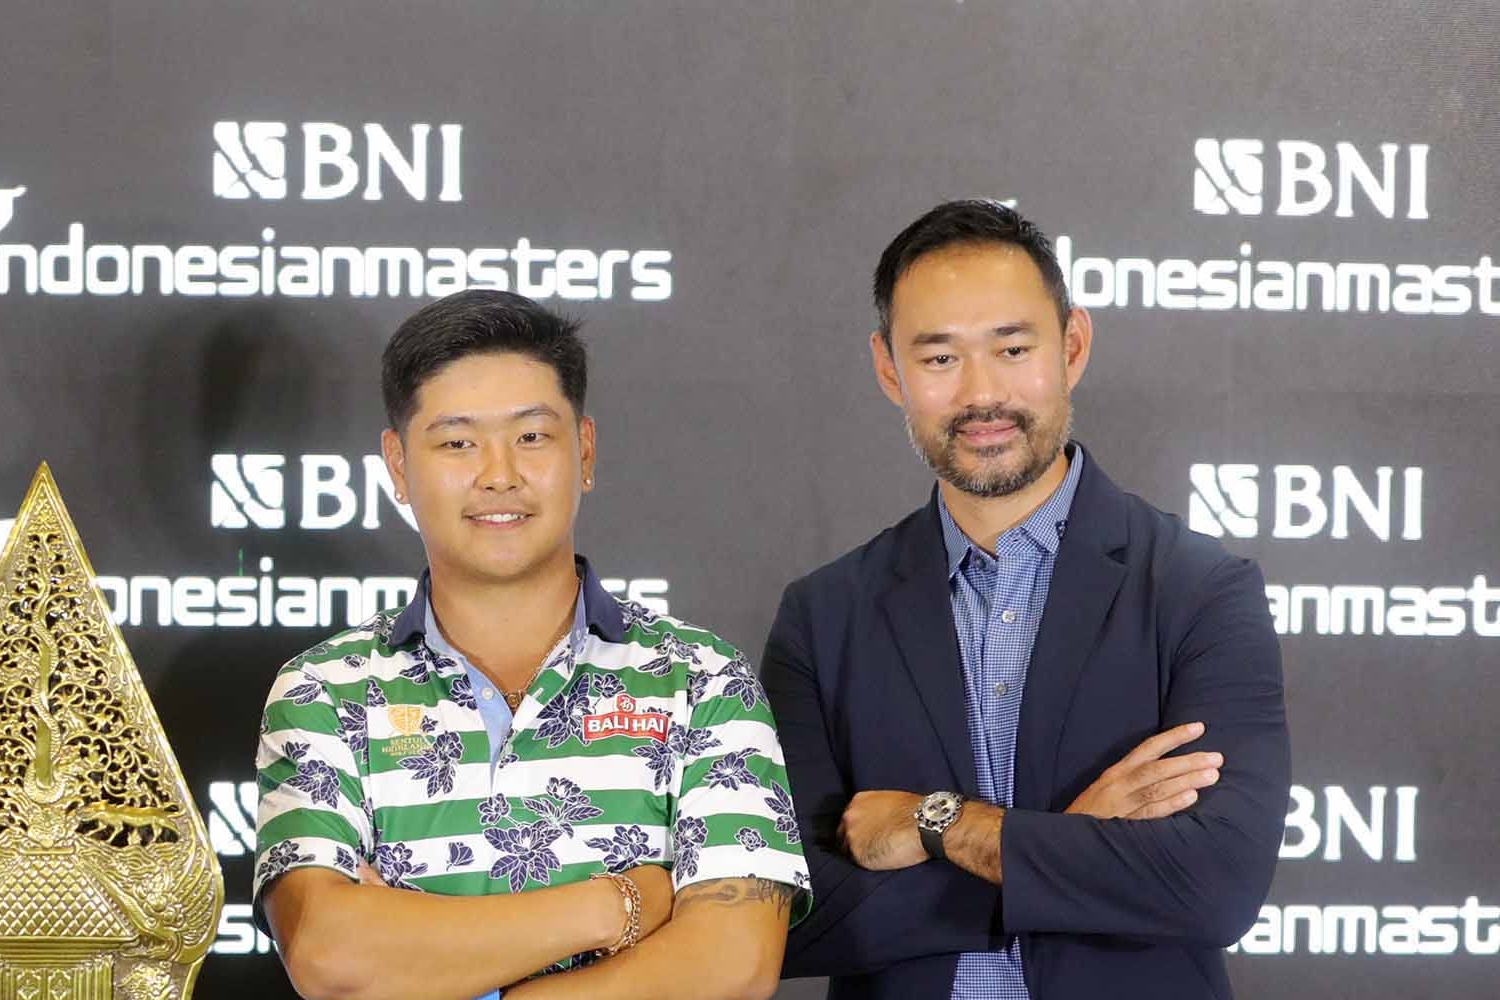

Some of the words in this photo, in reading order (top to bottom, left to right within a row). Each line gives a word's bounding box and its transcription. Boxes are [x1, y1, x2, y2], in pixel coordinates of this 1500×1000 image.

[300, 121, 463, 202] BNI
[1275, 139, 1431, 220] BNI
[299, 454, 421, 533] BN
[1271, 464, 1424, 543] BNI
[587, 715, 629, 733] BALI
[632, 717, 664, 734] HAI
[1278, 784, 1419, 862] BNI
